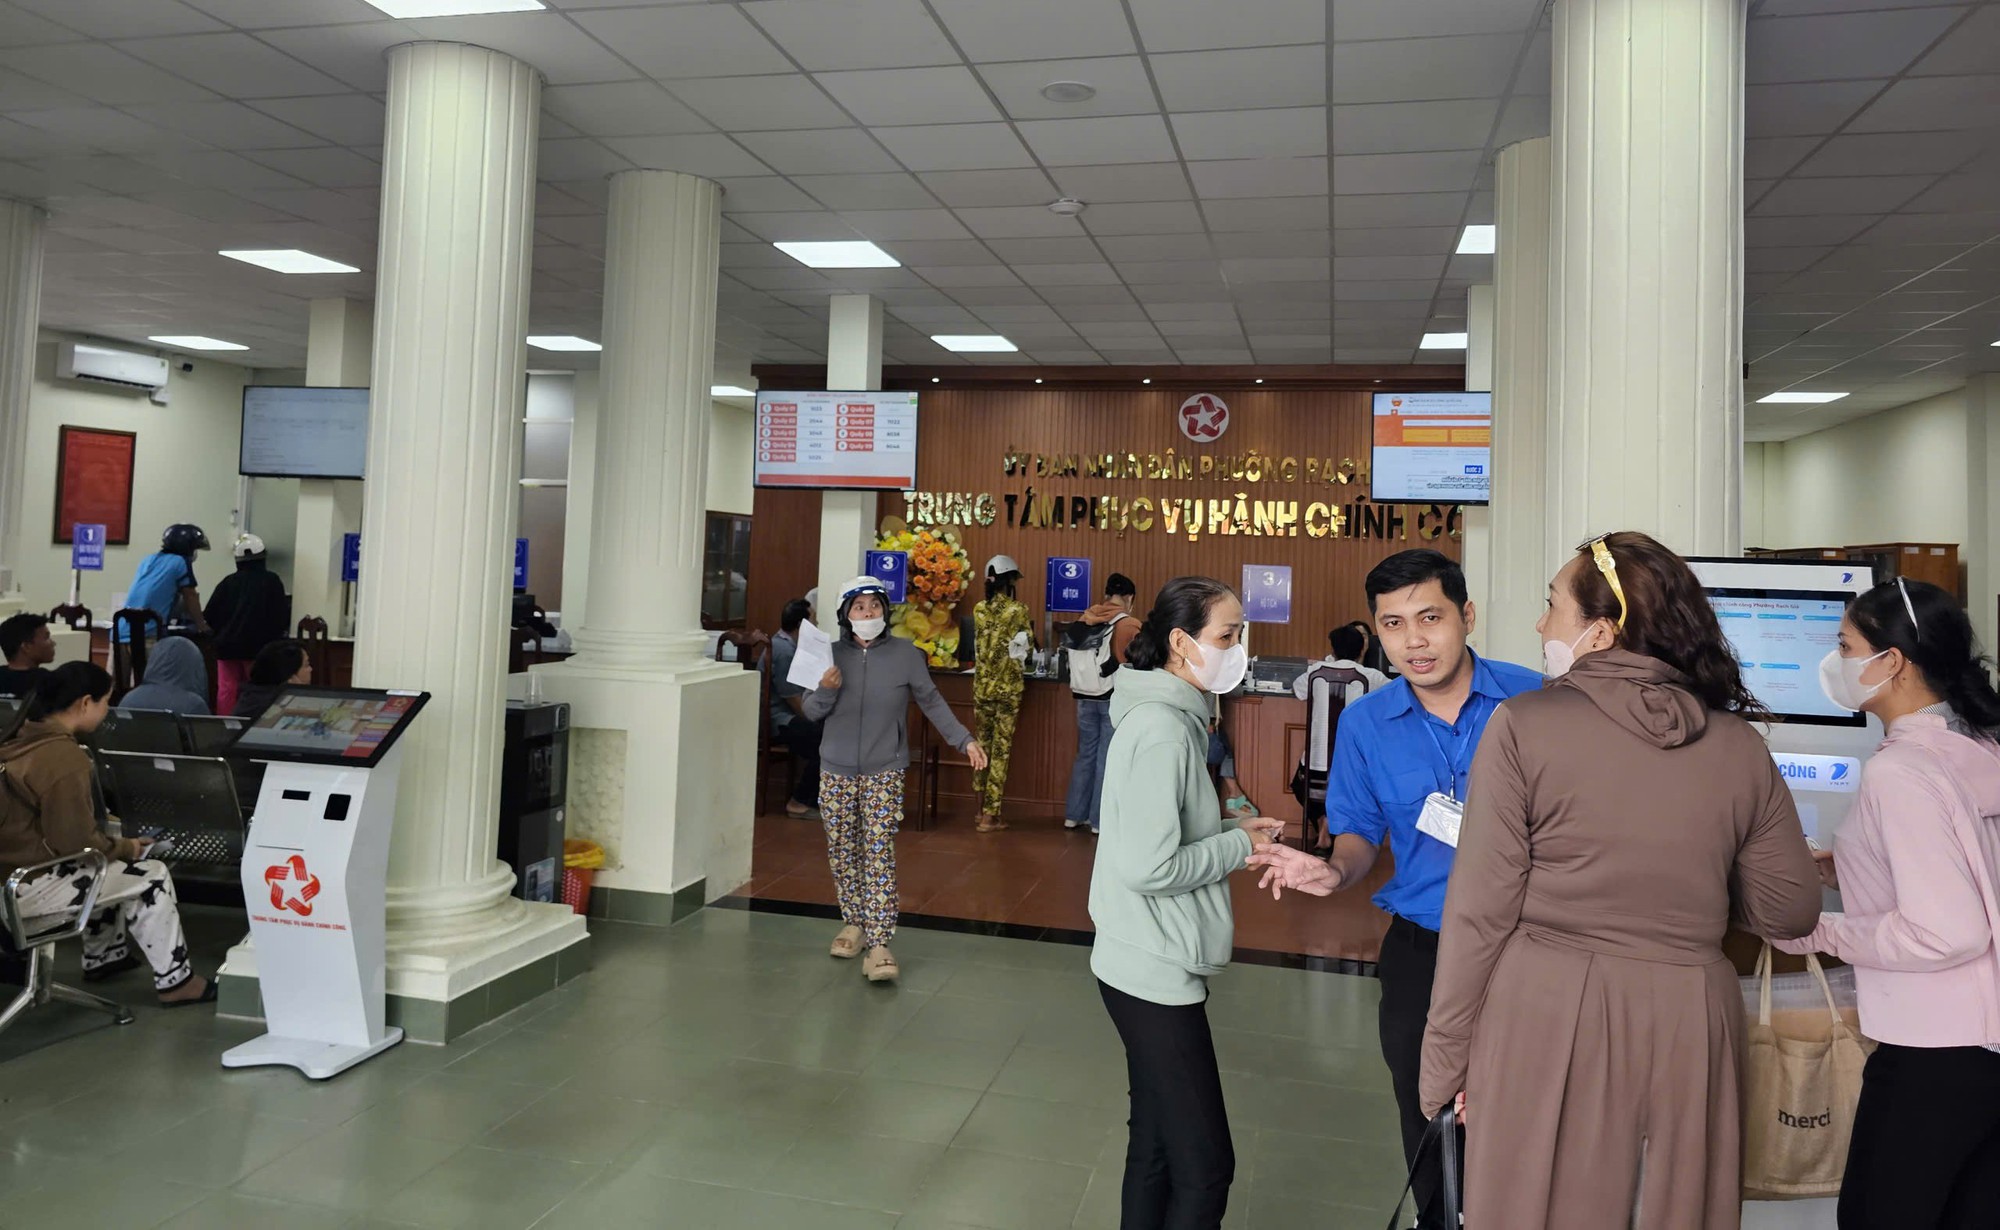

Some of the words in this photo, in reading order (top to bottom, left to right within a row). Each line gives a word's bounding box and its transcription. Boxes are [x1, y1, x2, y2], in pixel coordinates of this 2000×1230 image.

[1036, 452, 1080, 478] BAN
[1084, 449, 1143, 480] NHÂN
[1148, 447, 1194, 481] DÂN
[1305, 457, 1371, 489] RẠCH
[903, 490, 997, 526] TRUNG
[1004, 486, 1065, 529] TÂM
[1070, 495, 1154, 539] PHỤC
[1160, 498, 1203, 541] VỤ
[1208, 492, 1298, 538] HÀNH
[1304, 494, 1407, 540] CHÍNH
[87, 528, 94, 542] 1
[882, 556, 894, 570] 3
[1065, 563, 1078, 578] 3
[1263, 571, 1275, 586] 3
[1778, 761, 1817, 779] CÔNG
[1777, 1107, 1831, 1128] merci
